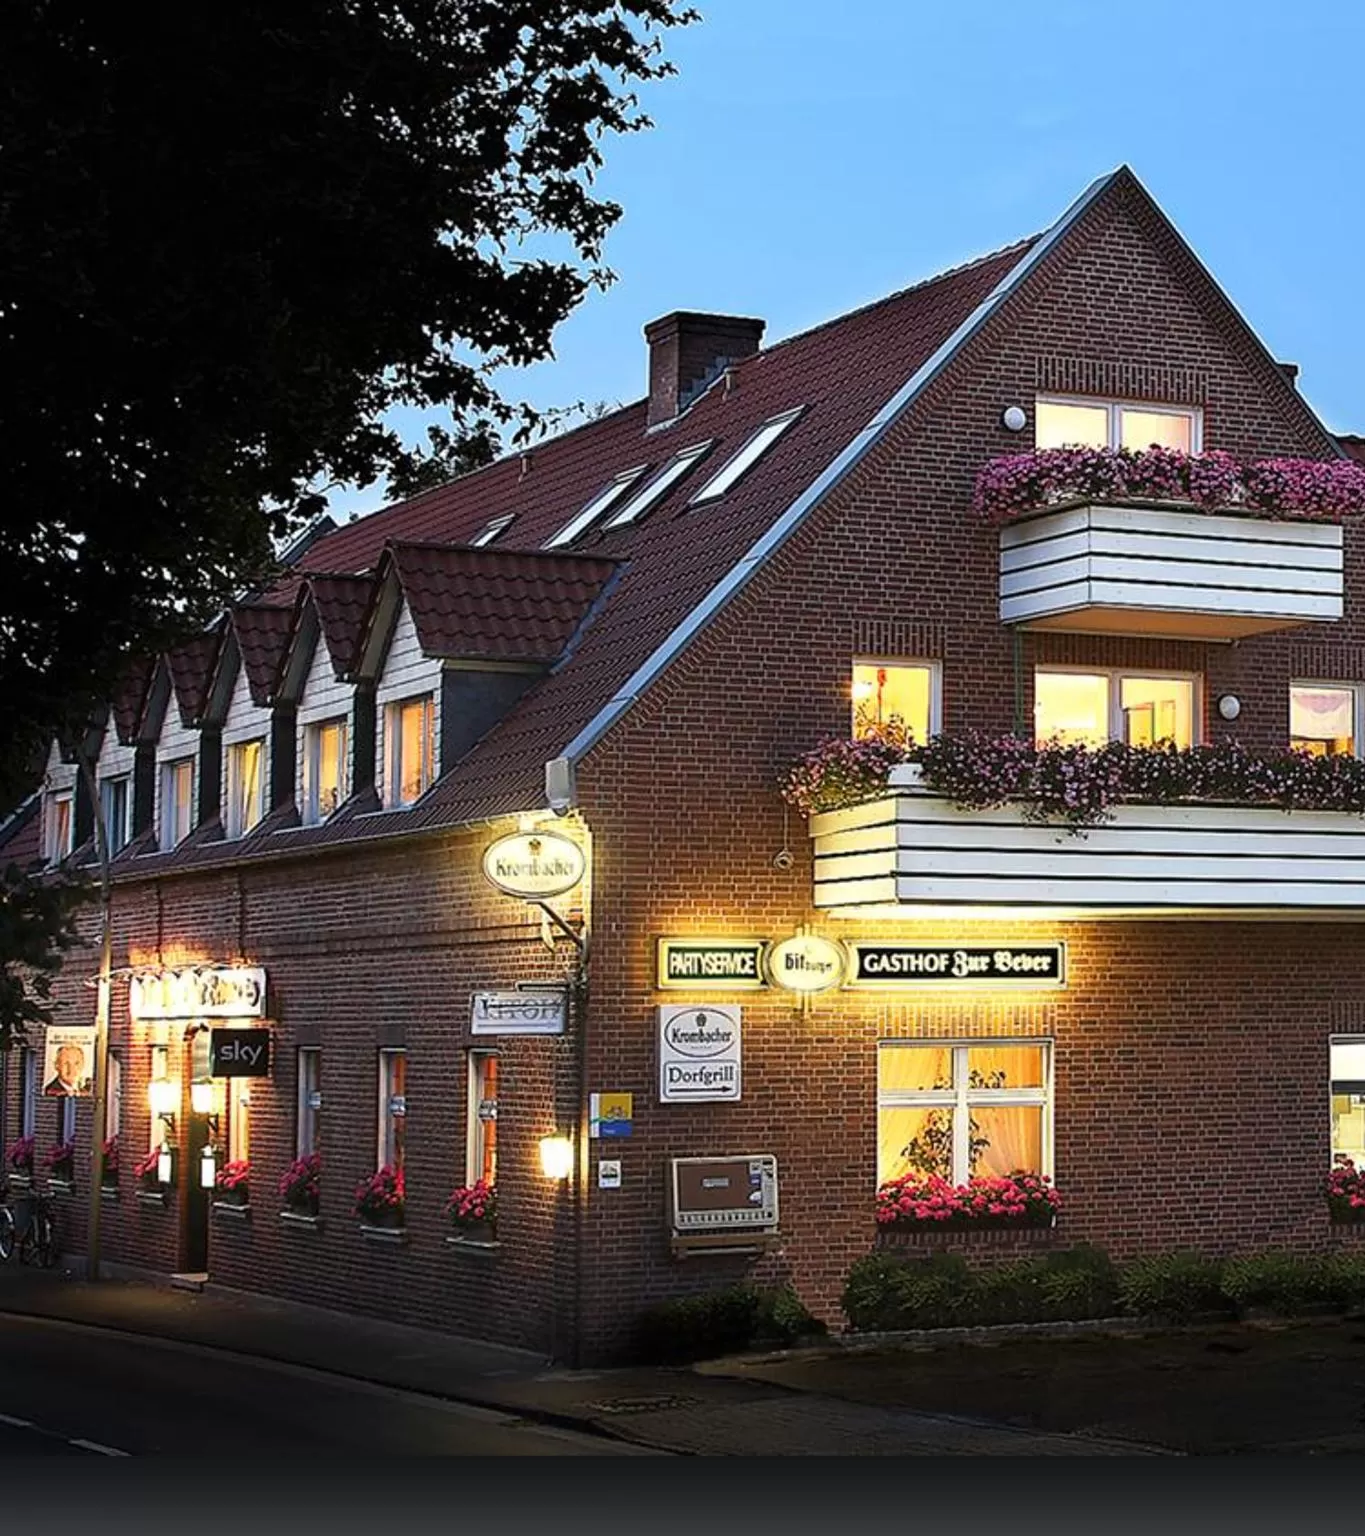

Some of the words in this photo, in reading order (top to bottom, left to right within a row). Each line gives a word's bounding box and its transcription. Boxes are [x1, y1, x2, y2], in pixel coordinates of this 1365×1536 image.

[495, 859, 575, 877] Krombacher
[669, 951, 755, 975] PARTYSERVICE
[863, 953, 950, 973] GASTHOF
[951, 950, 991, 977] Zur
[993, 950, 1052, 973] Bever
[672, 1028, 733, 1044] Krombacher
[220, 1040, 263, 1065] sky
[668, 1065, 734, 1085] Dorfgrill
